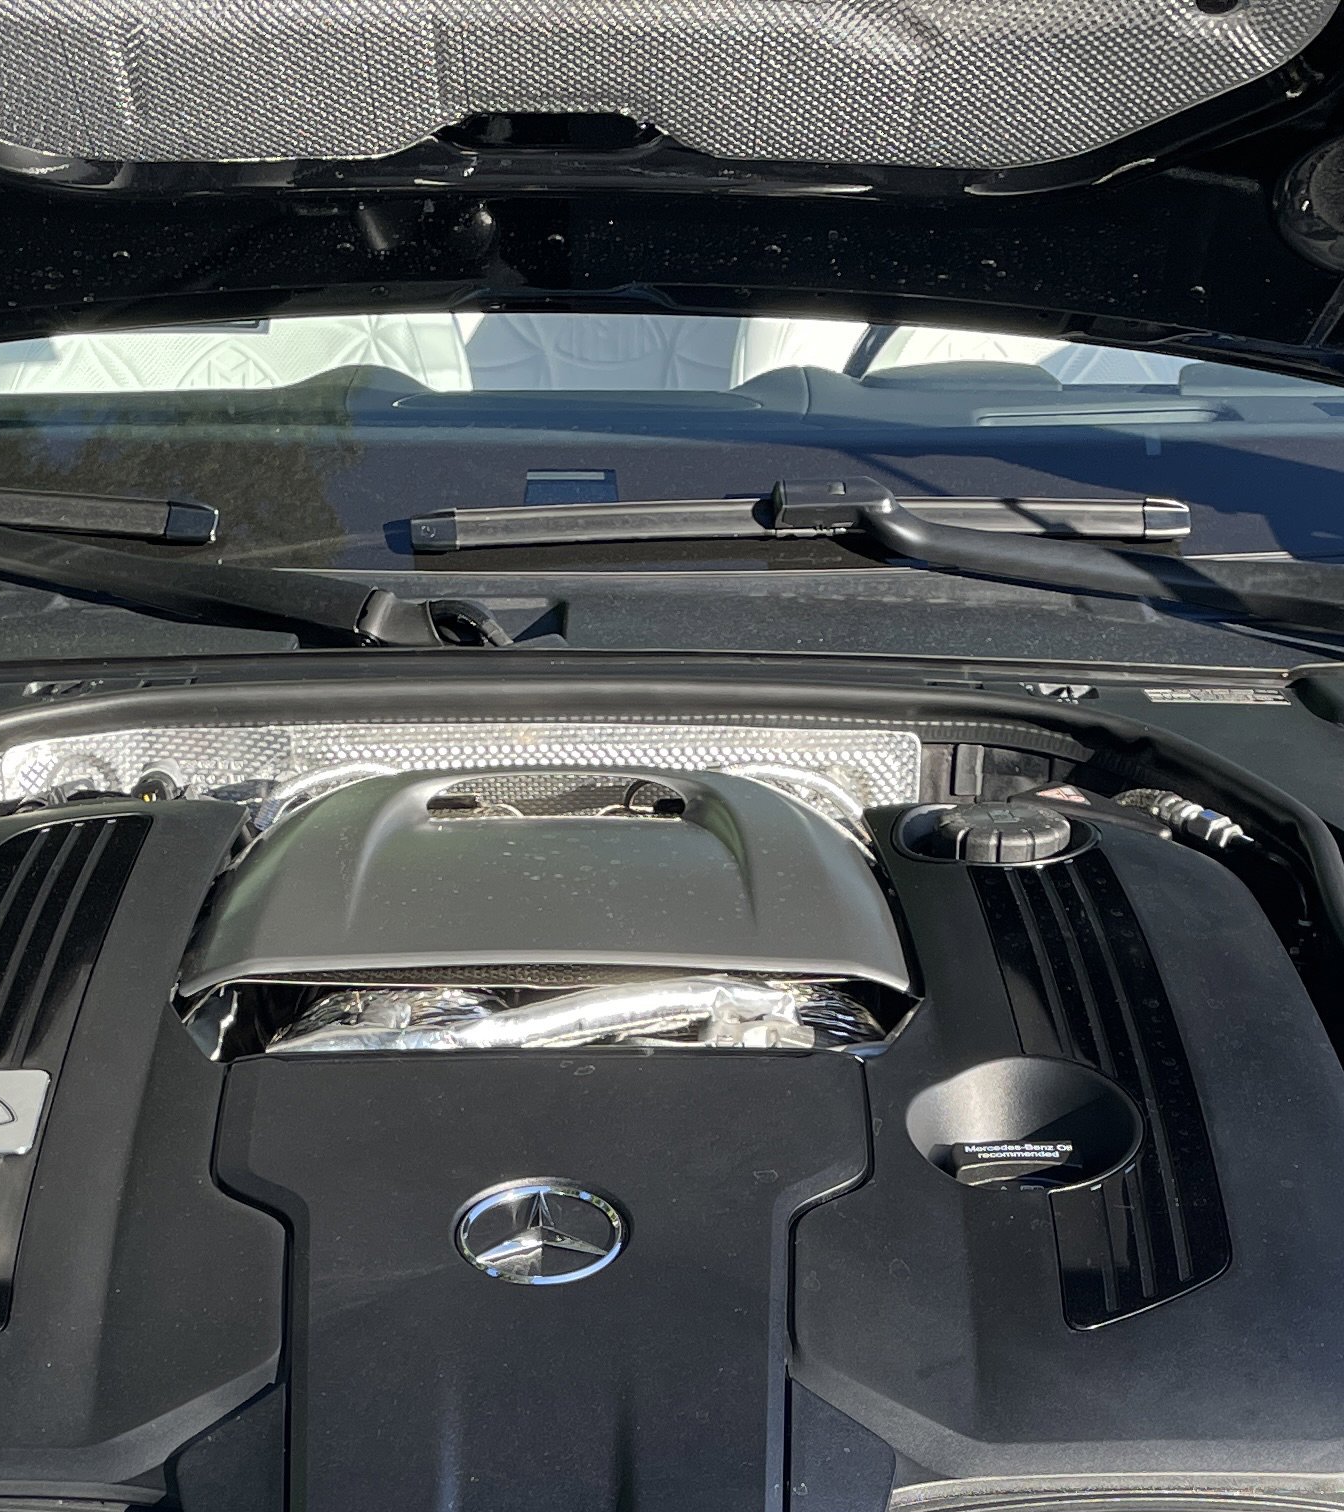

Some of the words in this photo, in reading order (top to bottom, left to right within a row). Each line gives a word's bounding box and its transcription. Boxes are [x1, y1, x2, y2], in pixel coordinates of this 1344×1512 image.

[964, 1144, 1054, 1153] Mercedes-Benz
[1057, 1144, 1073, 1152] Oil
[977, 1151, 1060, 1159] recommended
